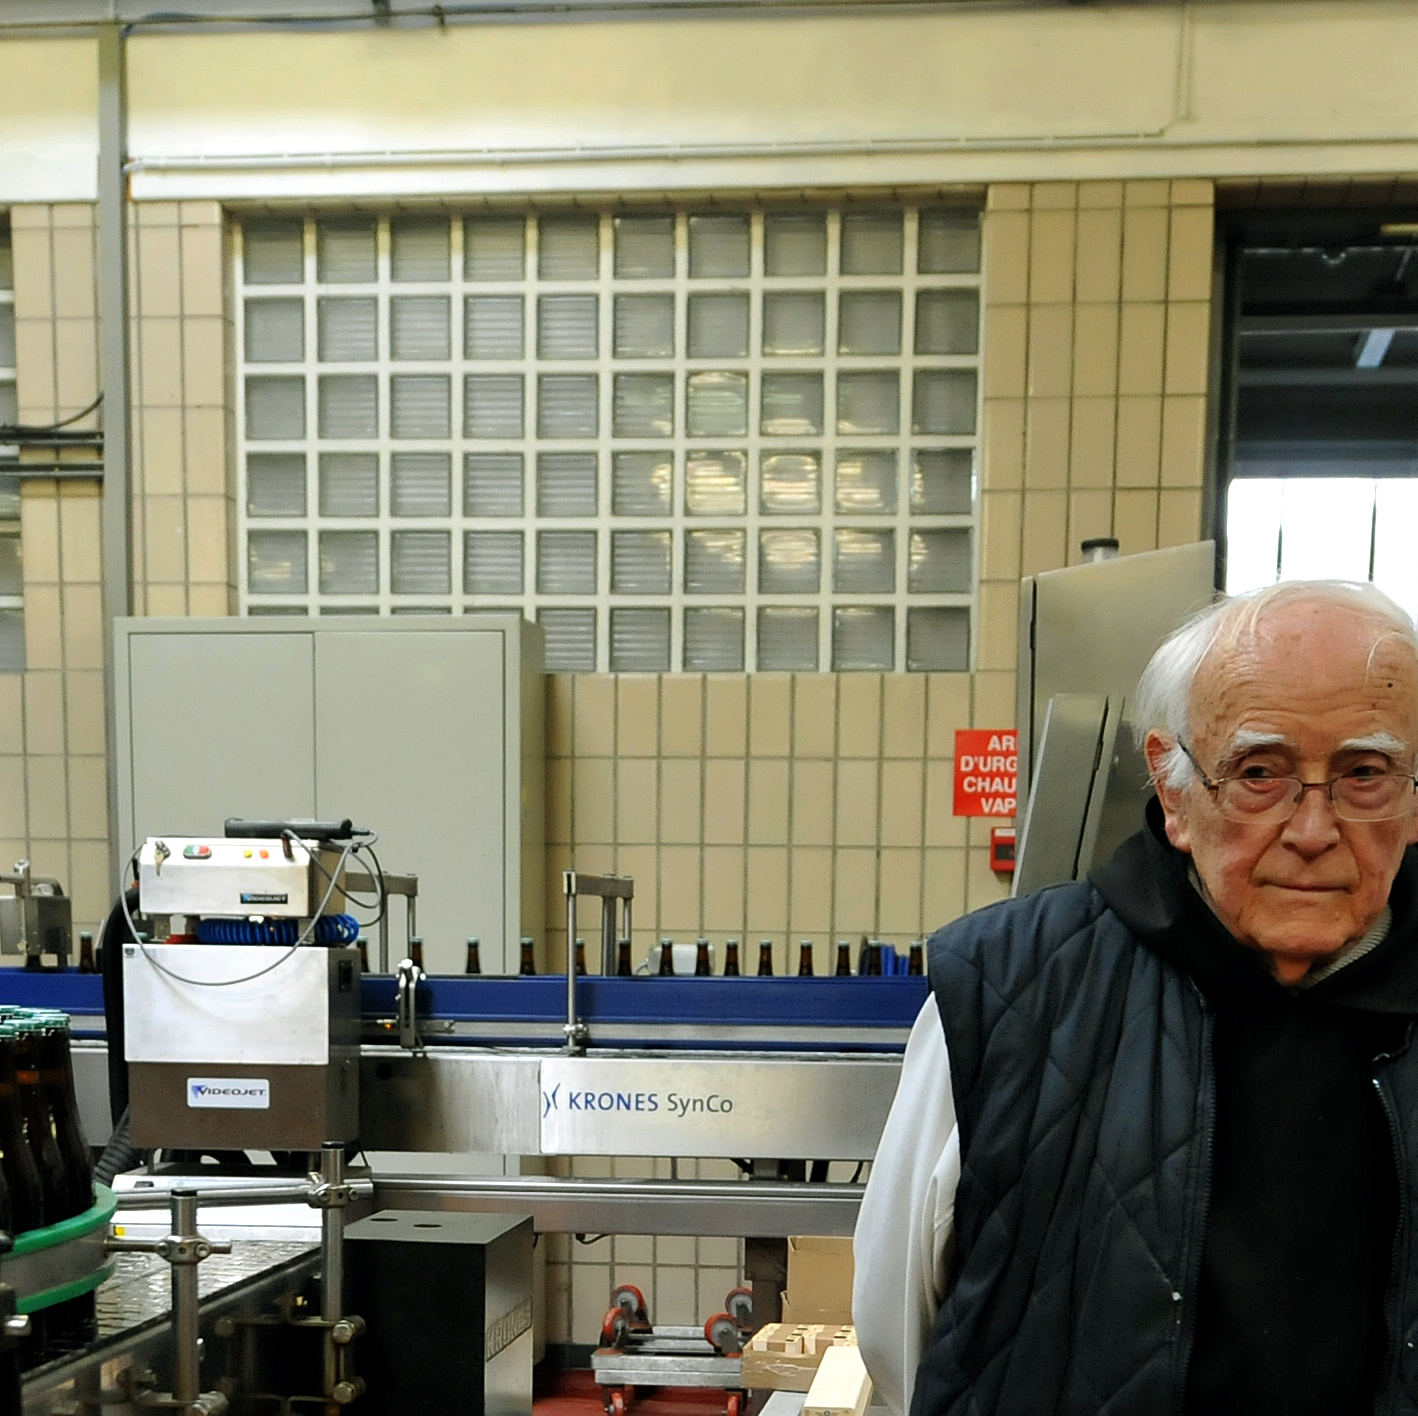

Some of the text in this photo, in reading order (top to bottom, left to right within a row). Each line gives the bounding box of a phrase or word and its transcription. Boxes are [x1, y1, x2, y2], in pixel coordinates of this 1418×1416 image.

[198, 1085, 266, 1096] VIDEOJET
[568, 1091, 733, 1118] KRONES SynCo
